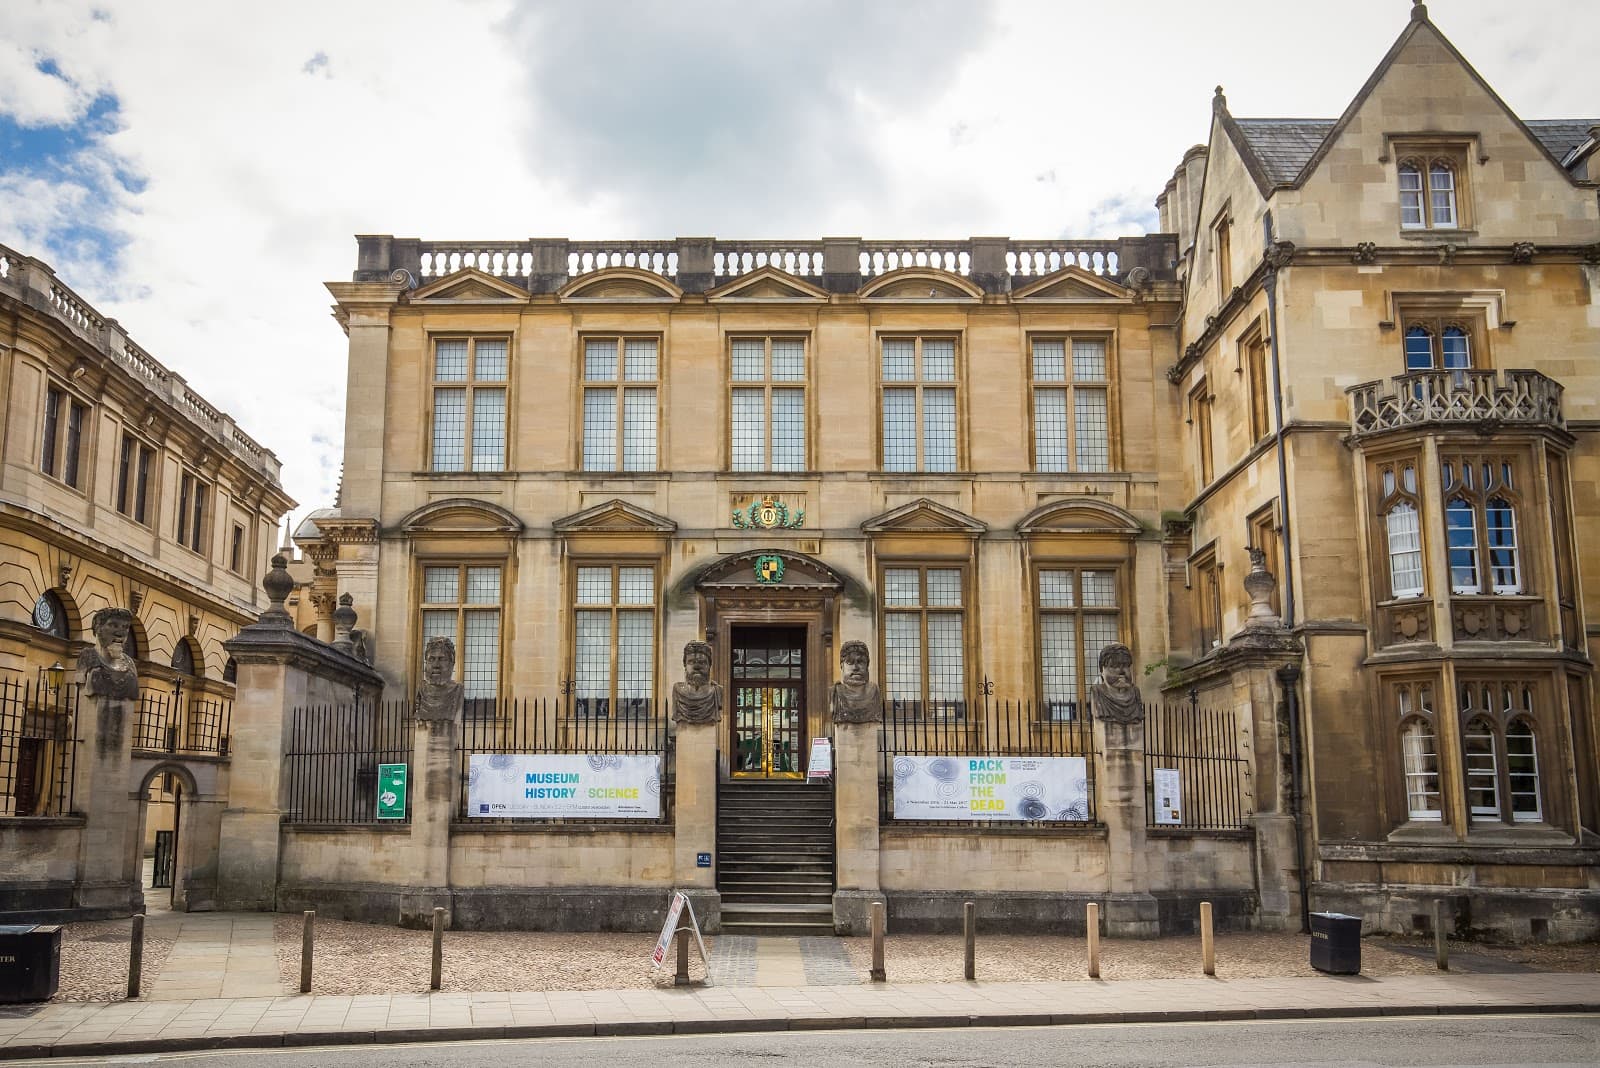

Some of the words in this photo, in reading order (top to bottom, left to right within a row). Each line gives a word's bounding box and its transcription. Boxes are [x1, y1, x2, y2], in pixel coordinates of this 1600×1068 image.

[969, 759, 1003, 771] BACK
[525, 773, 580, 784] MUSEUM
[969, 773, 1007, 785] FROM
[525, 788, 577, 799] HISTORY
[588, 788, 639, 799] SCIENCE
[970, 786, 994, 797] THE
[970, 799, 1005, 811] DEAD
